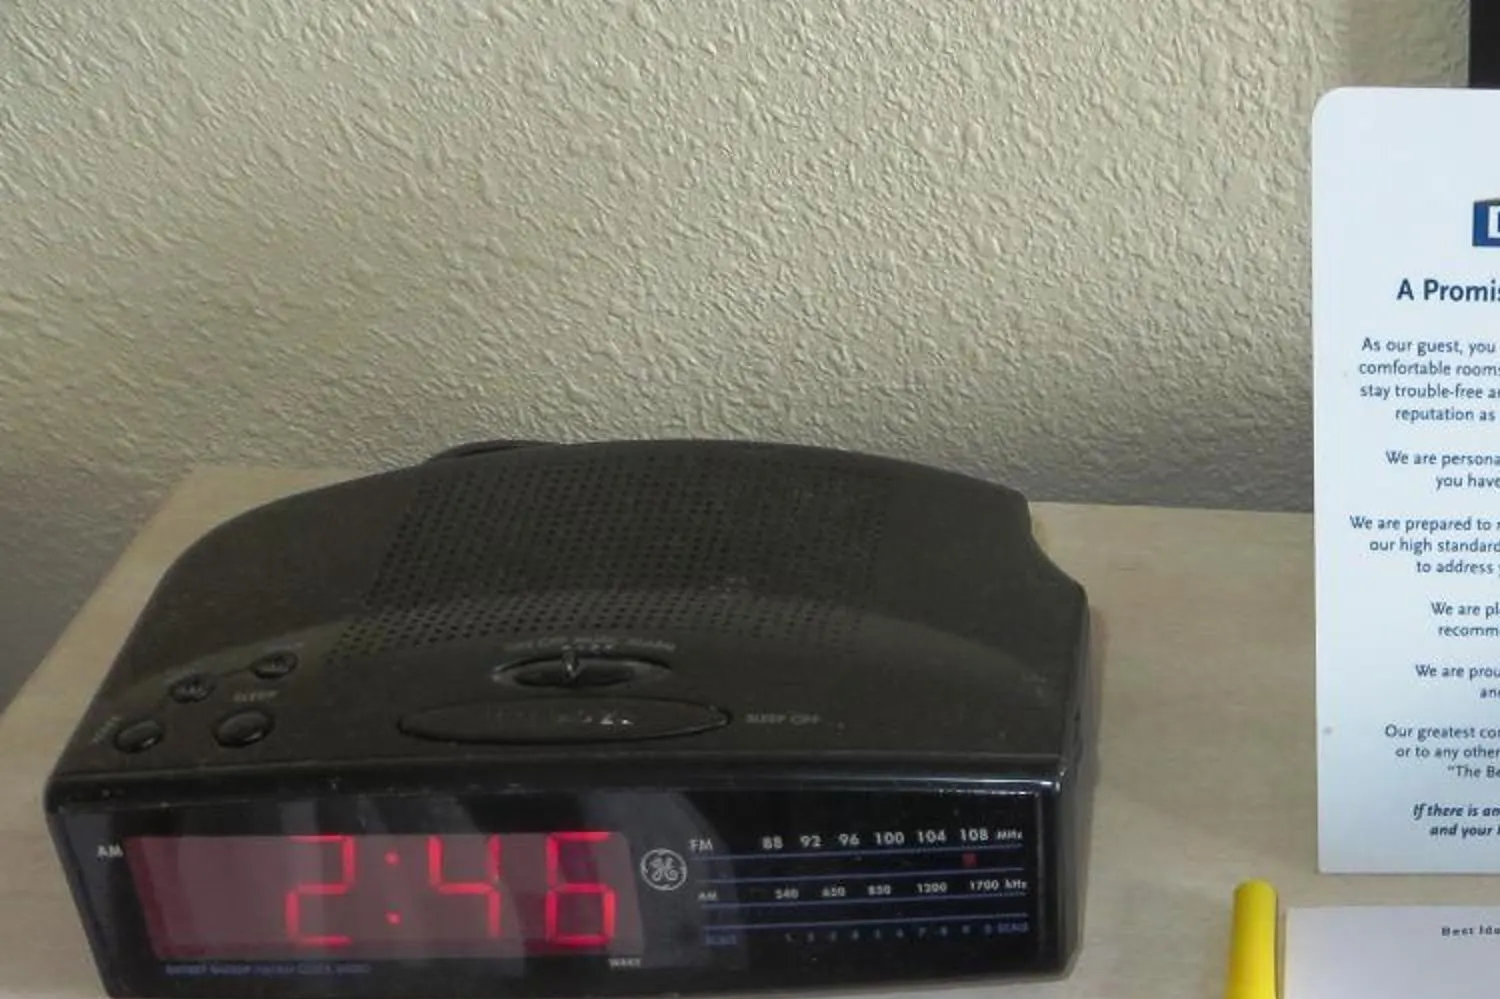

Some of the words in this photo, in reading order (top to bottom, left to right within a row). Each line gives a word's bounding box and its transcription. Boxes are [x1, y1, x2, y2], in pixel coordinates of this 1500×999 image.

[1396, 278, 1415, 301] A
[1361, 336, 1382, 353] As
[1385, 340, 1413, 353] our
[1416, 340, 1464, 357] guest,
[1468, 342, 1497, 358] you
[1358, 359, 1452, 376] comfortable
[1359, 384, 1391, 401] stay
[1394, 382, 1484, 399] trouble-free
[1395, 407, 1475, 424] reputation
[1478, 410, 1496, 422] as
[1385, 450, 1409, 465] We
[1413, 453, 1438, 465] are
[1435, 476, 1464, 491] you
[1430, 601, 1455, 616] We
[1457, 605, 1481, 617] are
[1412, 803, 1426, 820] If
[1425, 803, 1464, 817] there
[1467, 803, 1479, 817] is
[1429, 822, 1458, 837] and
[1460, 826, 1494, 839] your
[689, 838, 713, 851] FM
[763, 836, 784, 849] 88
[801, 835, 822, 848] 92
[839, 833, 860, 846] 96
[874, 831, 905, 845] 100
[917, 829, 947, 843] 104
[960, 828, 989, 842] 108
[285, 831, 617, 946] 2:46
